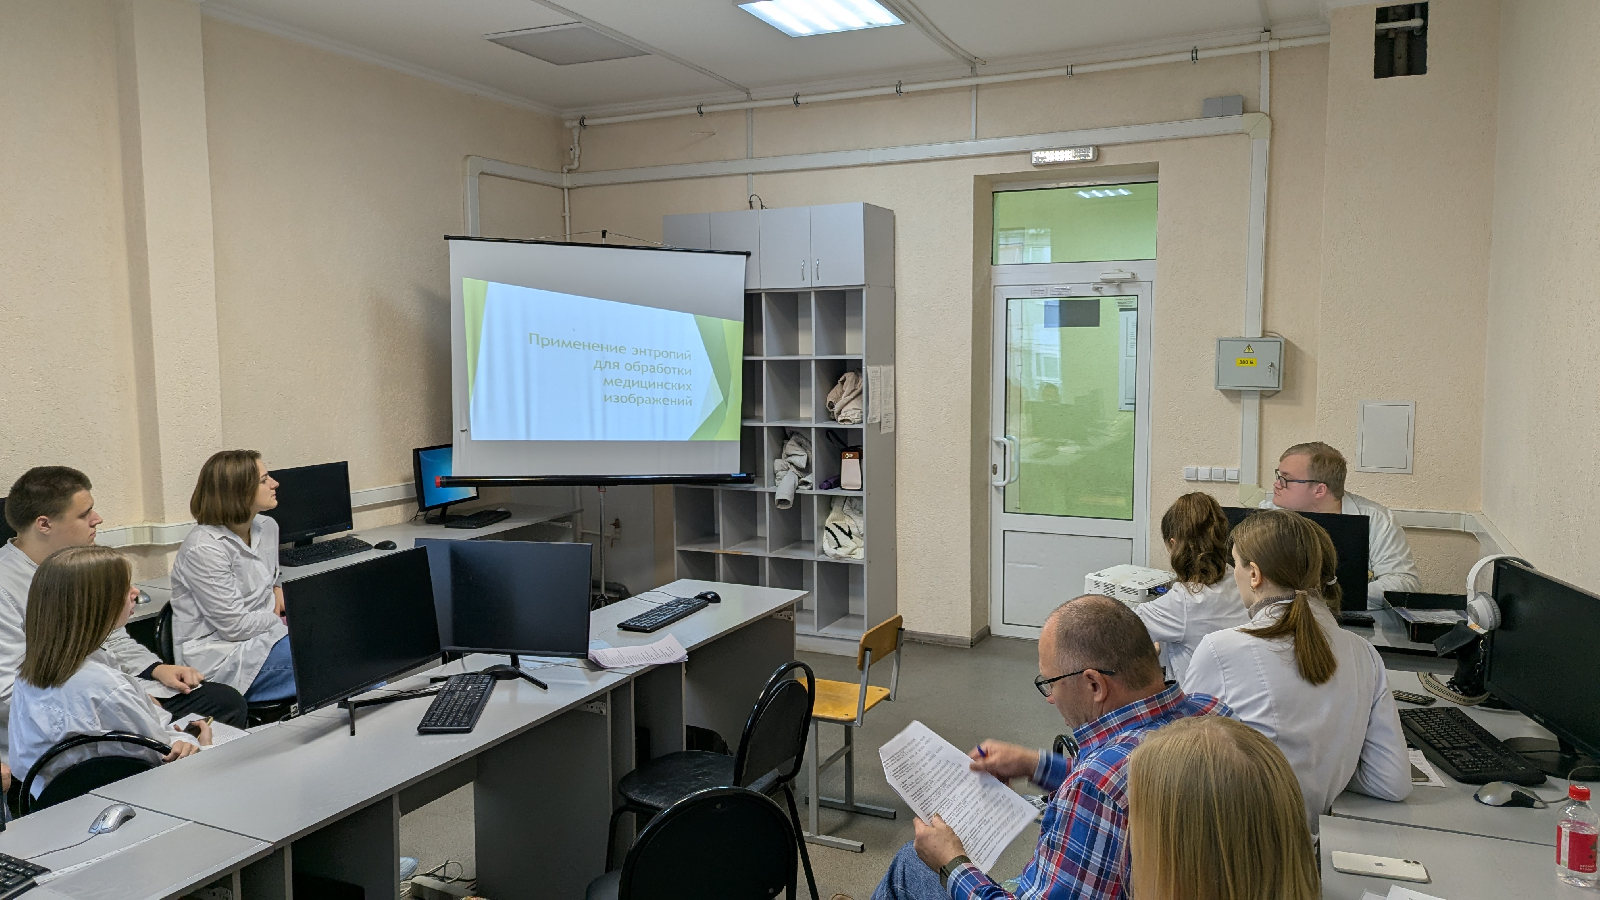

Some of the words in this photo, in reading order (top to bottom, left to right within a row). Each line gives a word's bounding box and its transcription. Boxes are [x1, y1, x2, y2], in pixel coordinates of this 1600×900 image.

[528, 333, 627, 355] Применение
[631, 348, 692, 361] энтропий
[593, 359, 620, 371] для
[624, 361, 692, 376] обработки
[603, 377, 692, 391] медицинских
[603, 393, 693, 407] изображений
